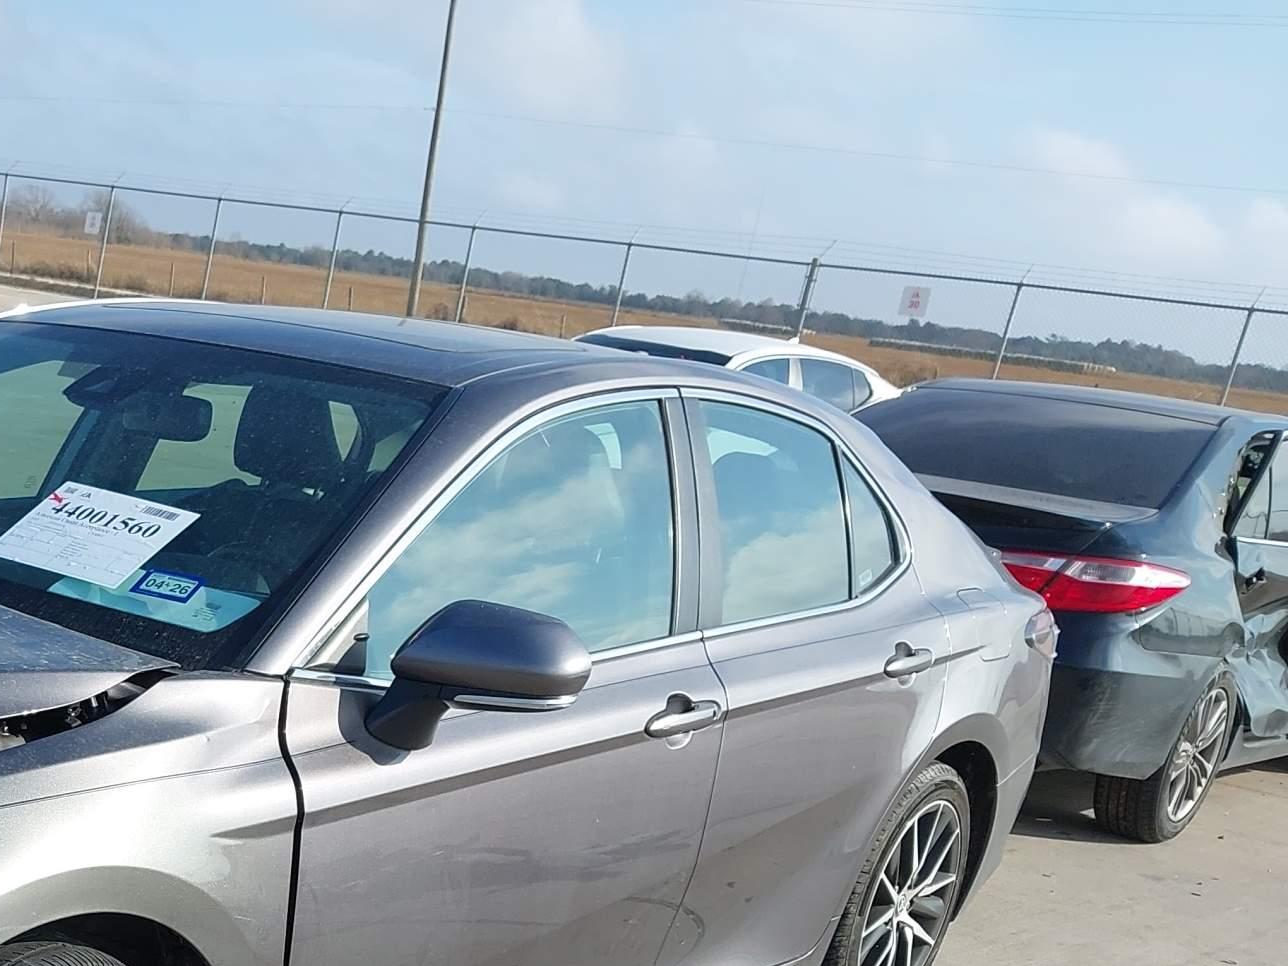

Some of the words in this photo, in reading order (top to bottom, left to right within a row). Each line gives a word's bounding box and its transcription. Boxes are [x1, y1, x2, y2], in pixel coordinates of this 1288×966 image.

[51, 501, 162, 539] 44001560
[145, 578, 165, 590] 04
[169, 583, 192, 595] 26
